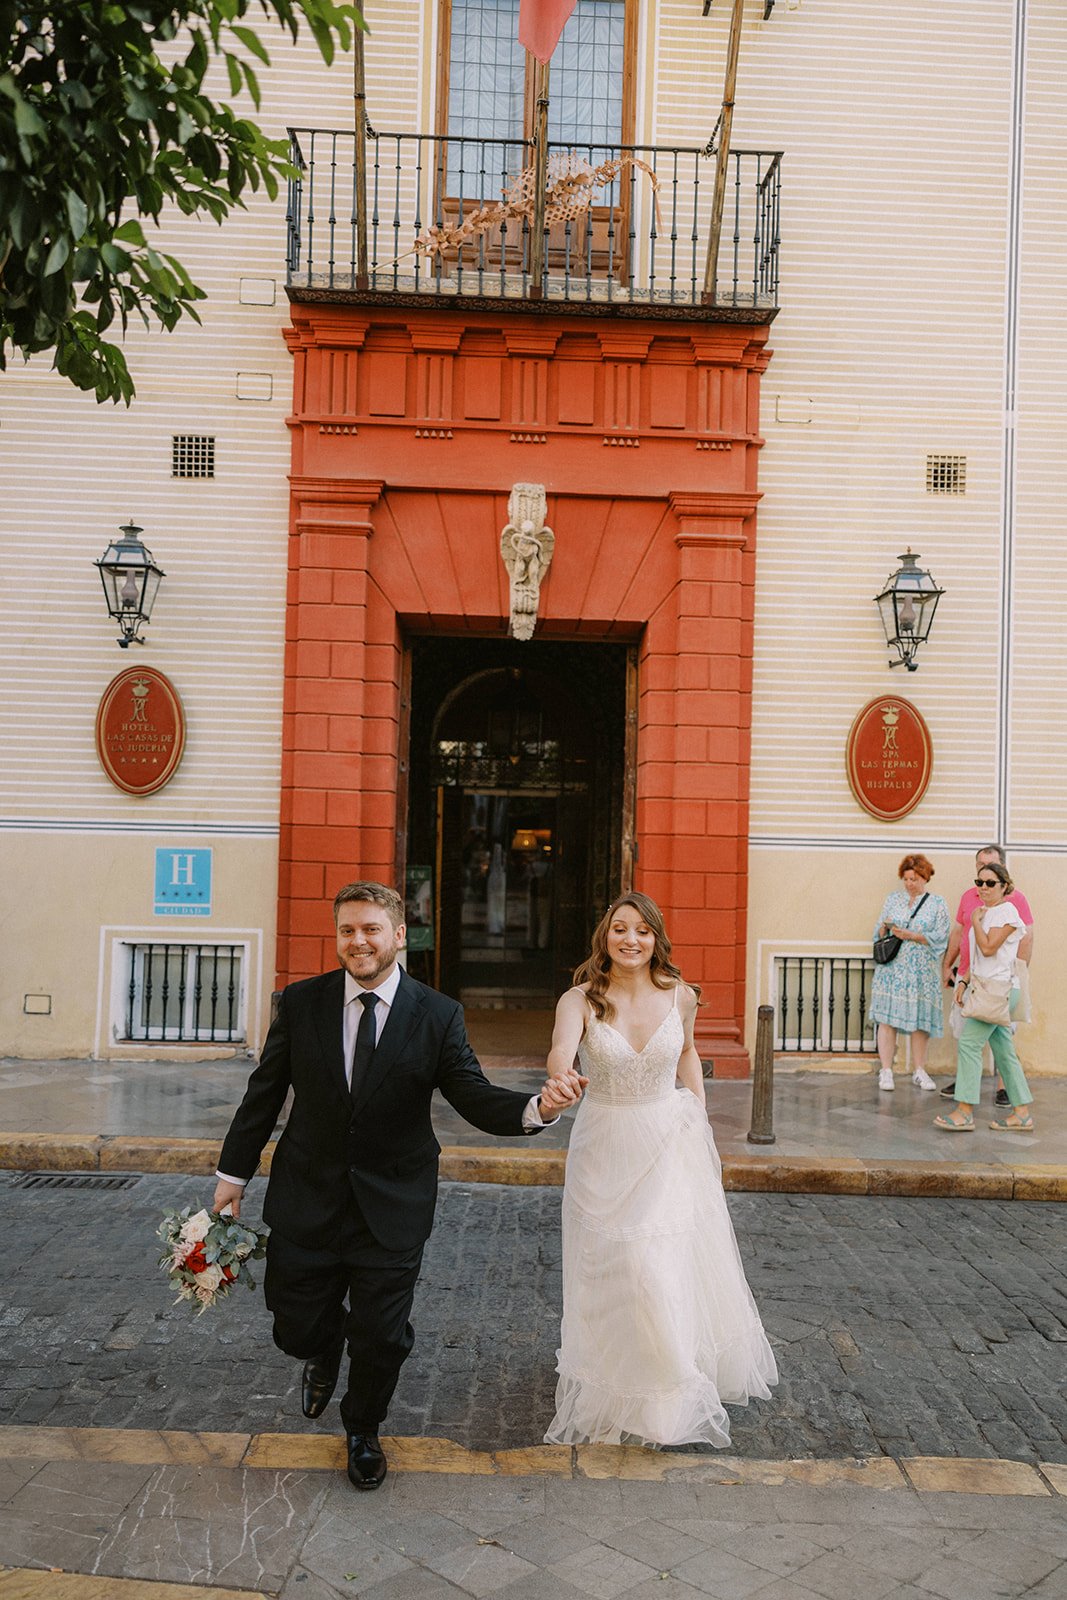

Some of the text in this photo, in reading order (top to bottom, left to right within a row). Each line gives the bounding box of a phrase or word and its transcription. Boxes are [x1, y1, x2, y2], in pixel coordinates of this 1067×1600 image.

[121, 723, 157, 732] HOTEL
[107, 733, 173, 743] LAS CASAS DE
[111, 744, 124, 752] LA
[882, 750, 900, 759] SPA
[861, 760, 919, 768] LAS TERMAS
[883, 770, 897, 778] DE
[866, 780, 913, 789] HISPALIS
[169, 854, 196, 885] H
